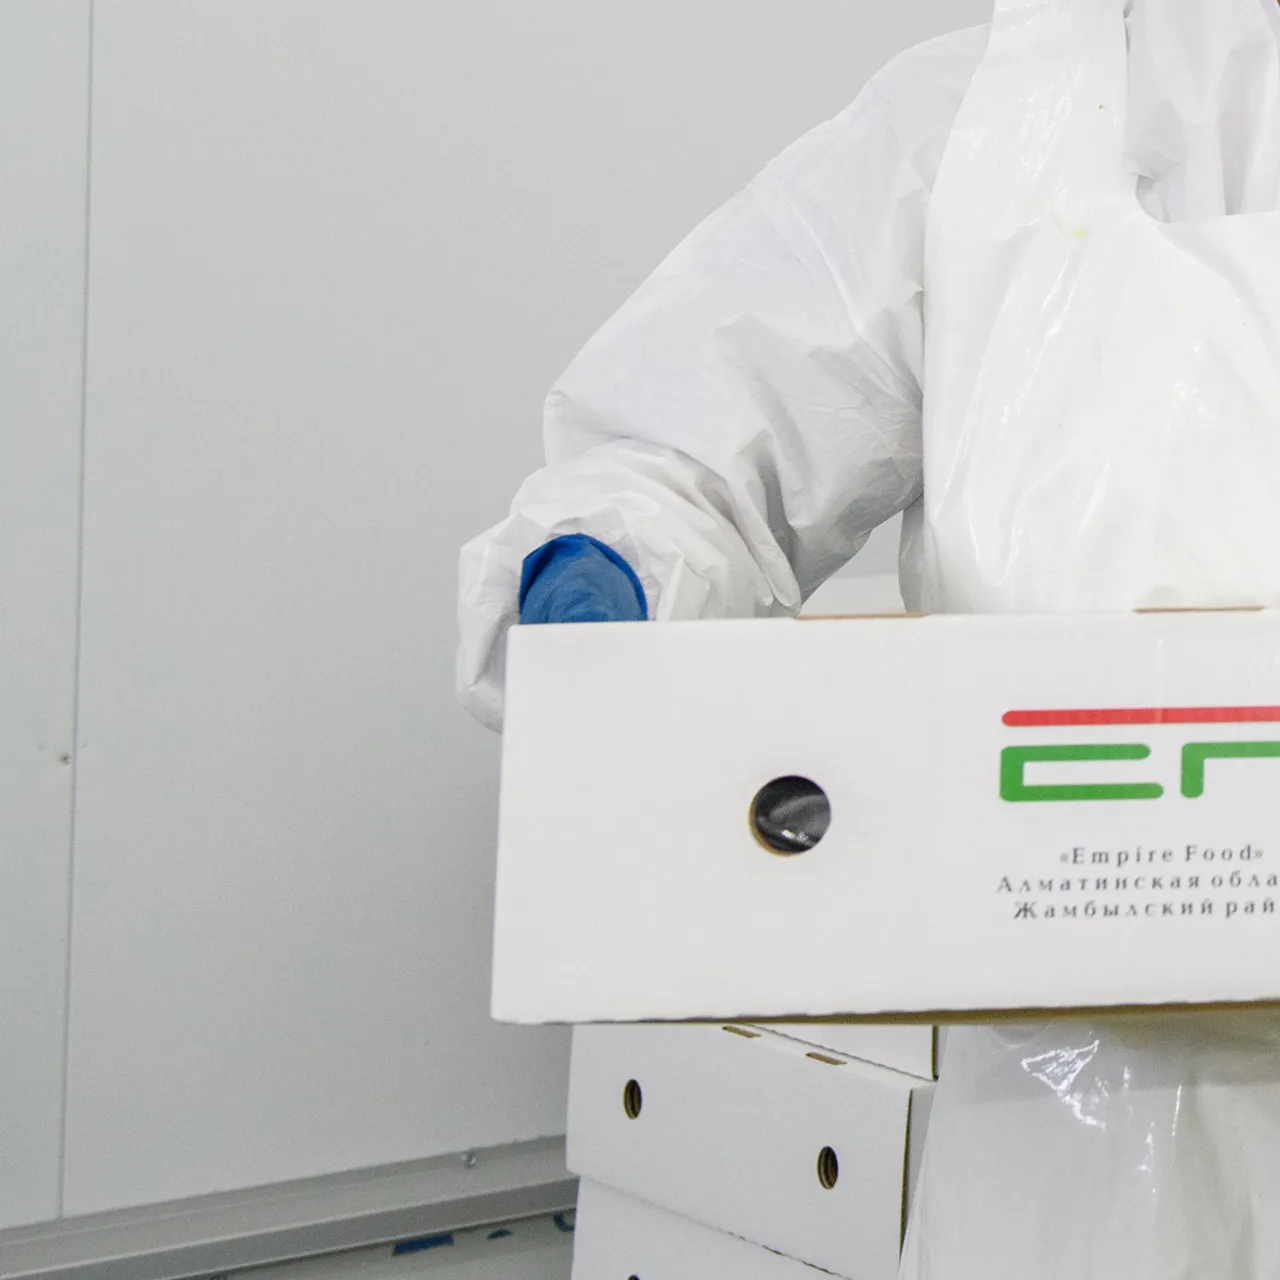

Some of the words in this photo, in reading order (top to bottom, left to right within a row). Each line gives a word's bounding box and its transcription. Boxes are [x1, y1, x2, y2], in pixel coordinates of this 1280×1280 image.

[1059, 846, 1173, 869] «Empire
[1184, 843, 1264, 863] Food»
[997, 874, 1200, 893] Алматинская
[1012, 898, 1214, 920] Жамбылский
